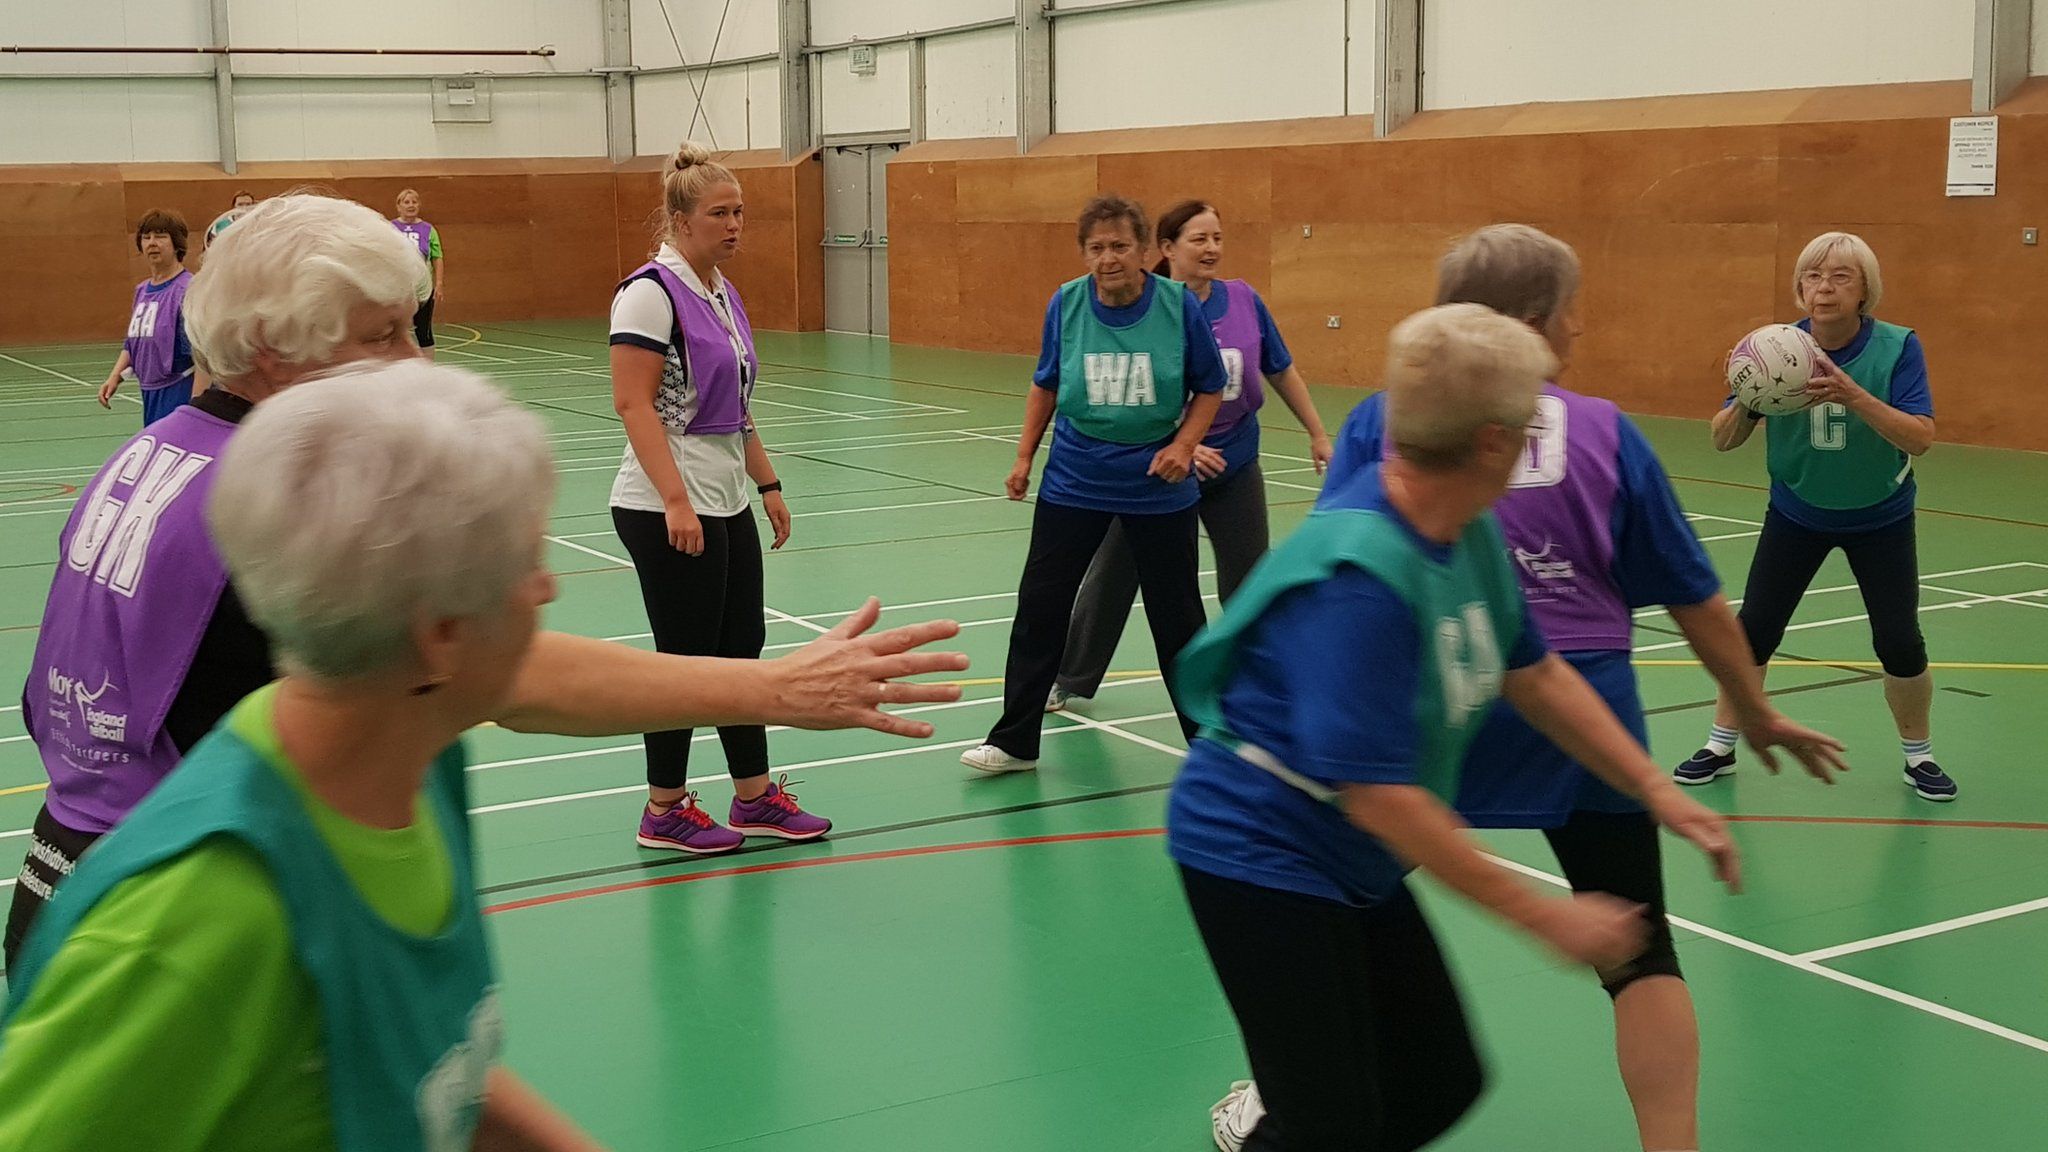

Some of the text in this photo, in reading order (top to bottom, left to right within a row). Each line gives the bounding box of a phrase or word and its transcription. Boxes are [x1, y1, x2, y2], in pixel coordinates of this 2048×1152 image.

[127, 301, 159, 338] GA
[1083, 352, 1157, 406] WA
[1810, 402, 1847, 451] C
[68, 434, 214, 599] GK
